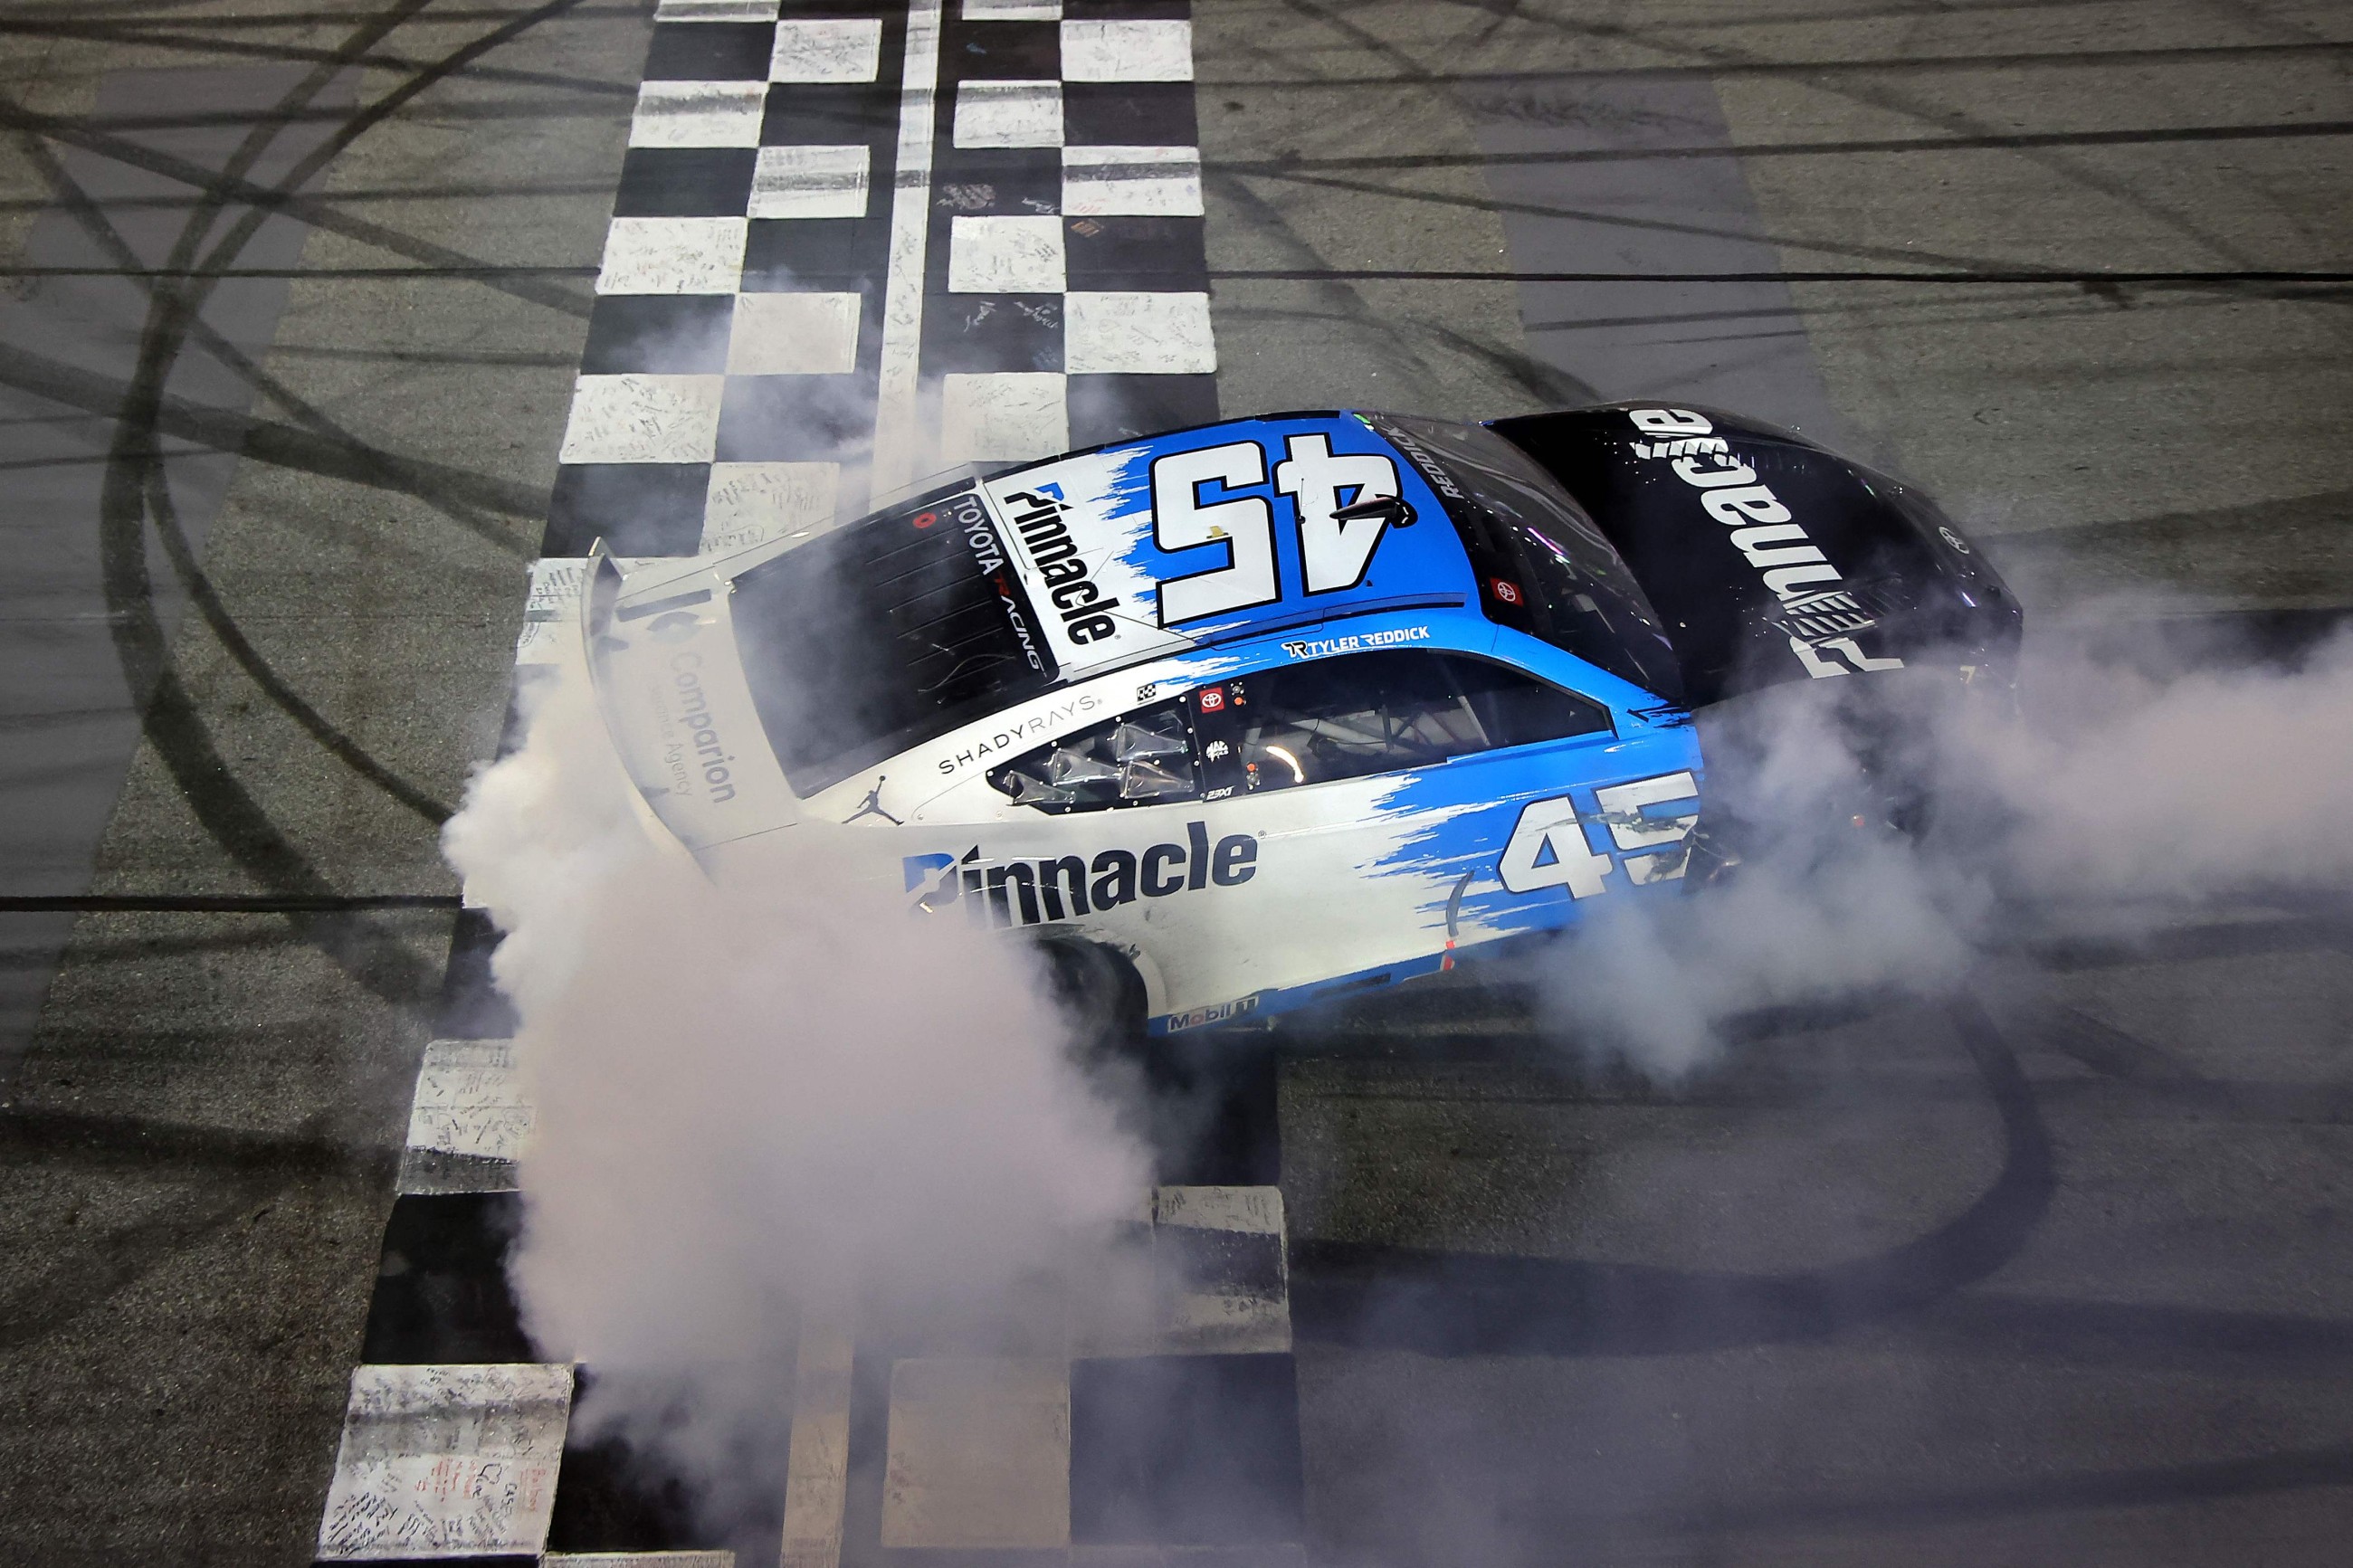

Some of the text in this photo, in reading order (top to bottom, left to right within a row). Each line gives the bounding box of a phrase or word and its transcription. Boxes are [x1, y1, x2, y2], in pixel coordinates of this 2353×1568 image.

[1380, 427, 1464, 499] REDDICK
[953, 497, 1004, 575] TOYOTA
[1004, 482, 1120, 646] Pinnacle
[1149, 433, 1403, 628] 45
[1308, 636, 1359, 654] TYLER
[1360, 626, 1431, 646] REDDICK
[664, 743, 692, 796] Agency
[671, 651, 736, 803] Comparion
[902, 821, 1257, 930] Pinnacle
[1499, 769, 1699, 900] 45
[1170, 1003, 1231, 1030] Mobil
